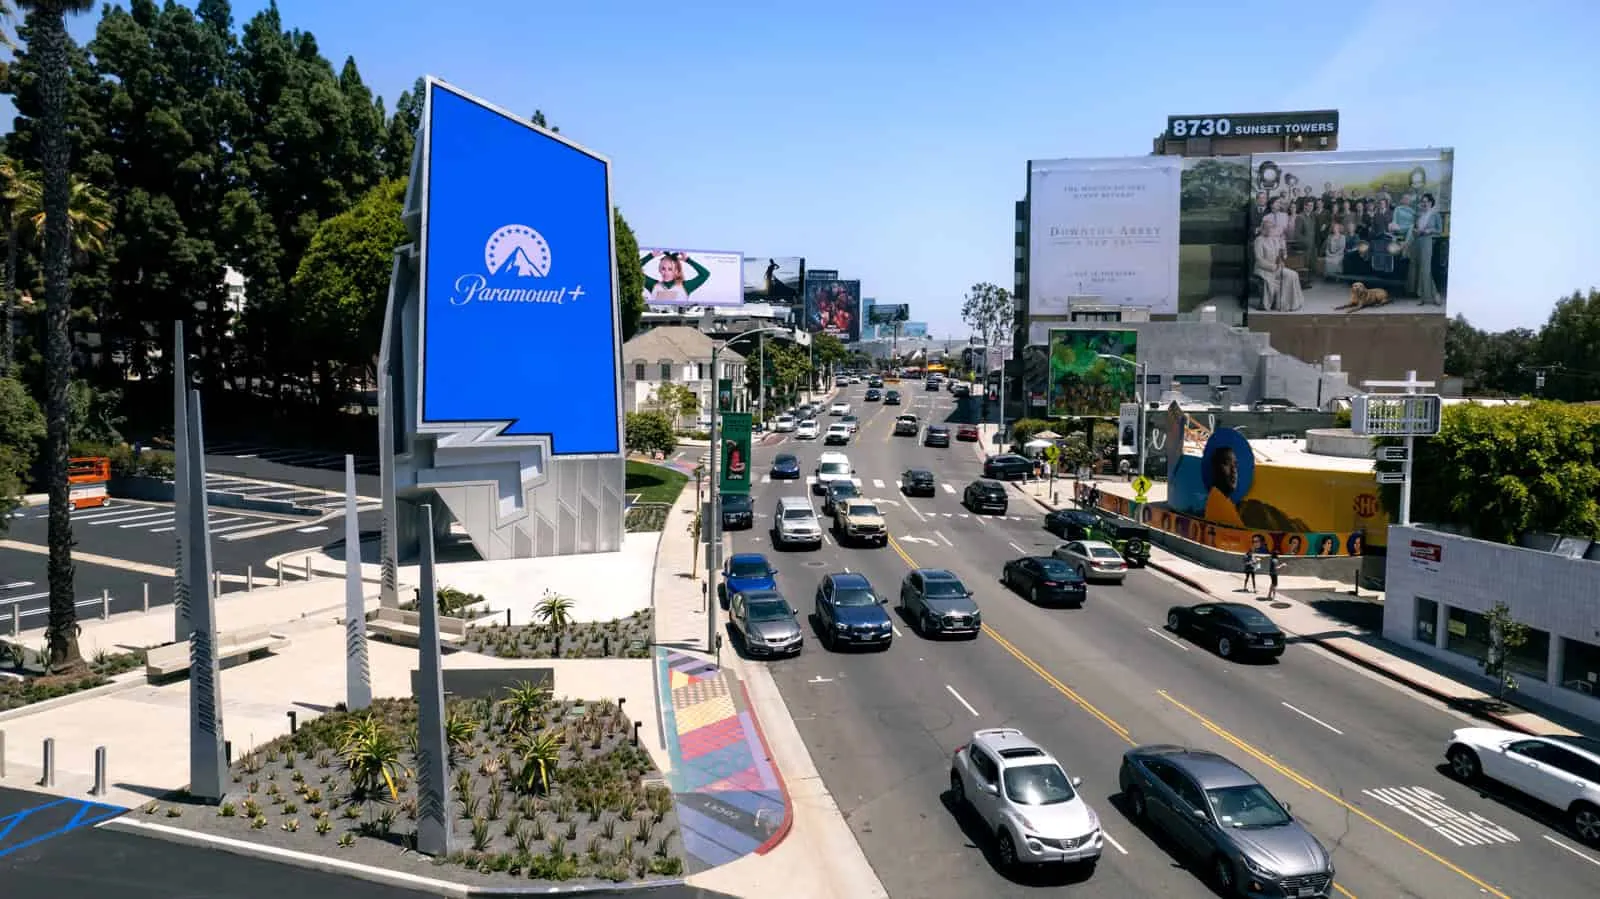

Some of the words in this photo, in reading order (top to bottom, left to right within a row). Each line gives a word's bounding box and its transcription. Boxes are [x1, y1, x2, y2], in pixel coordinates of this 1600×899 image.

[1173, 119, 1231, 136] 8730
[1235, 124, 1281, 135] SUNSET
[1285, 122, 1334, 133] TOWERS
[450, 273, 586, 306] Paramount+
